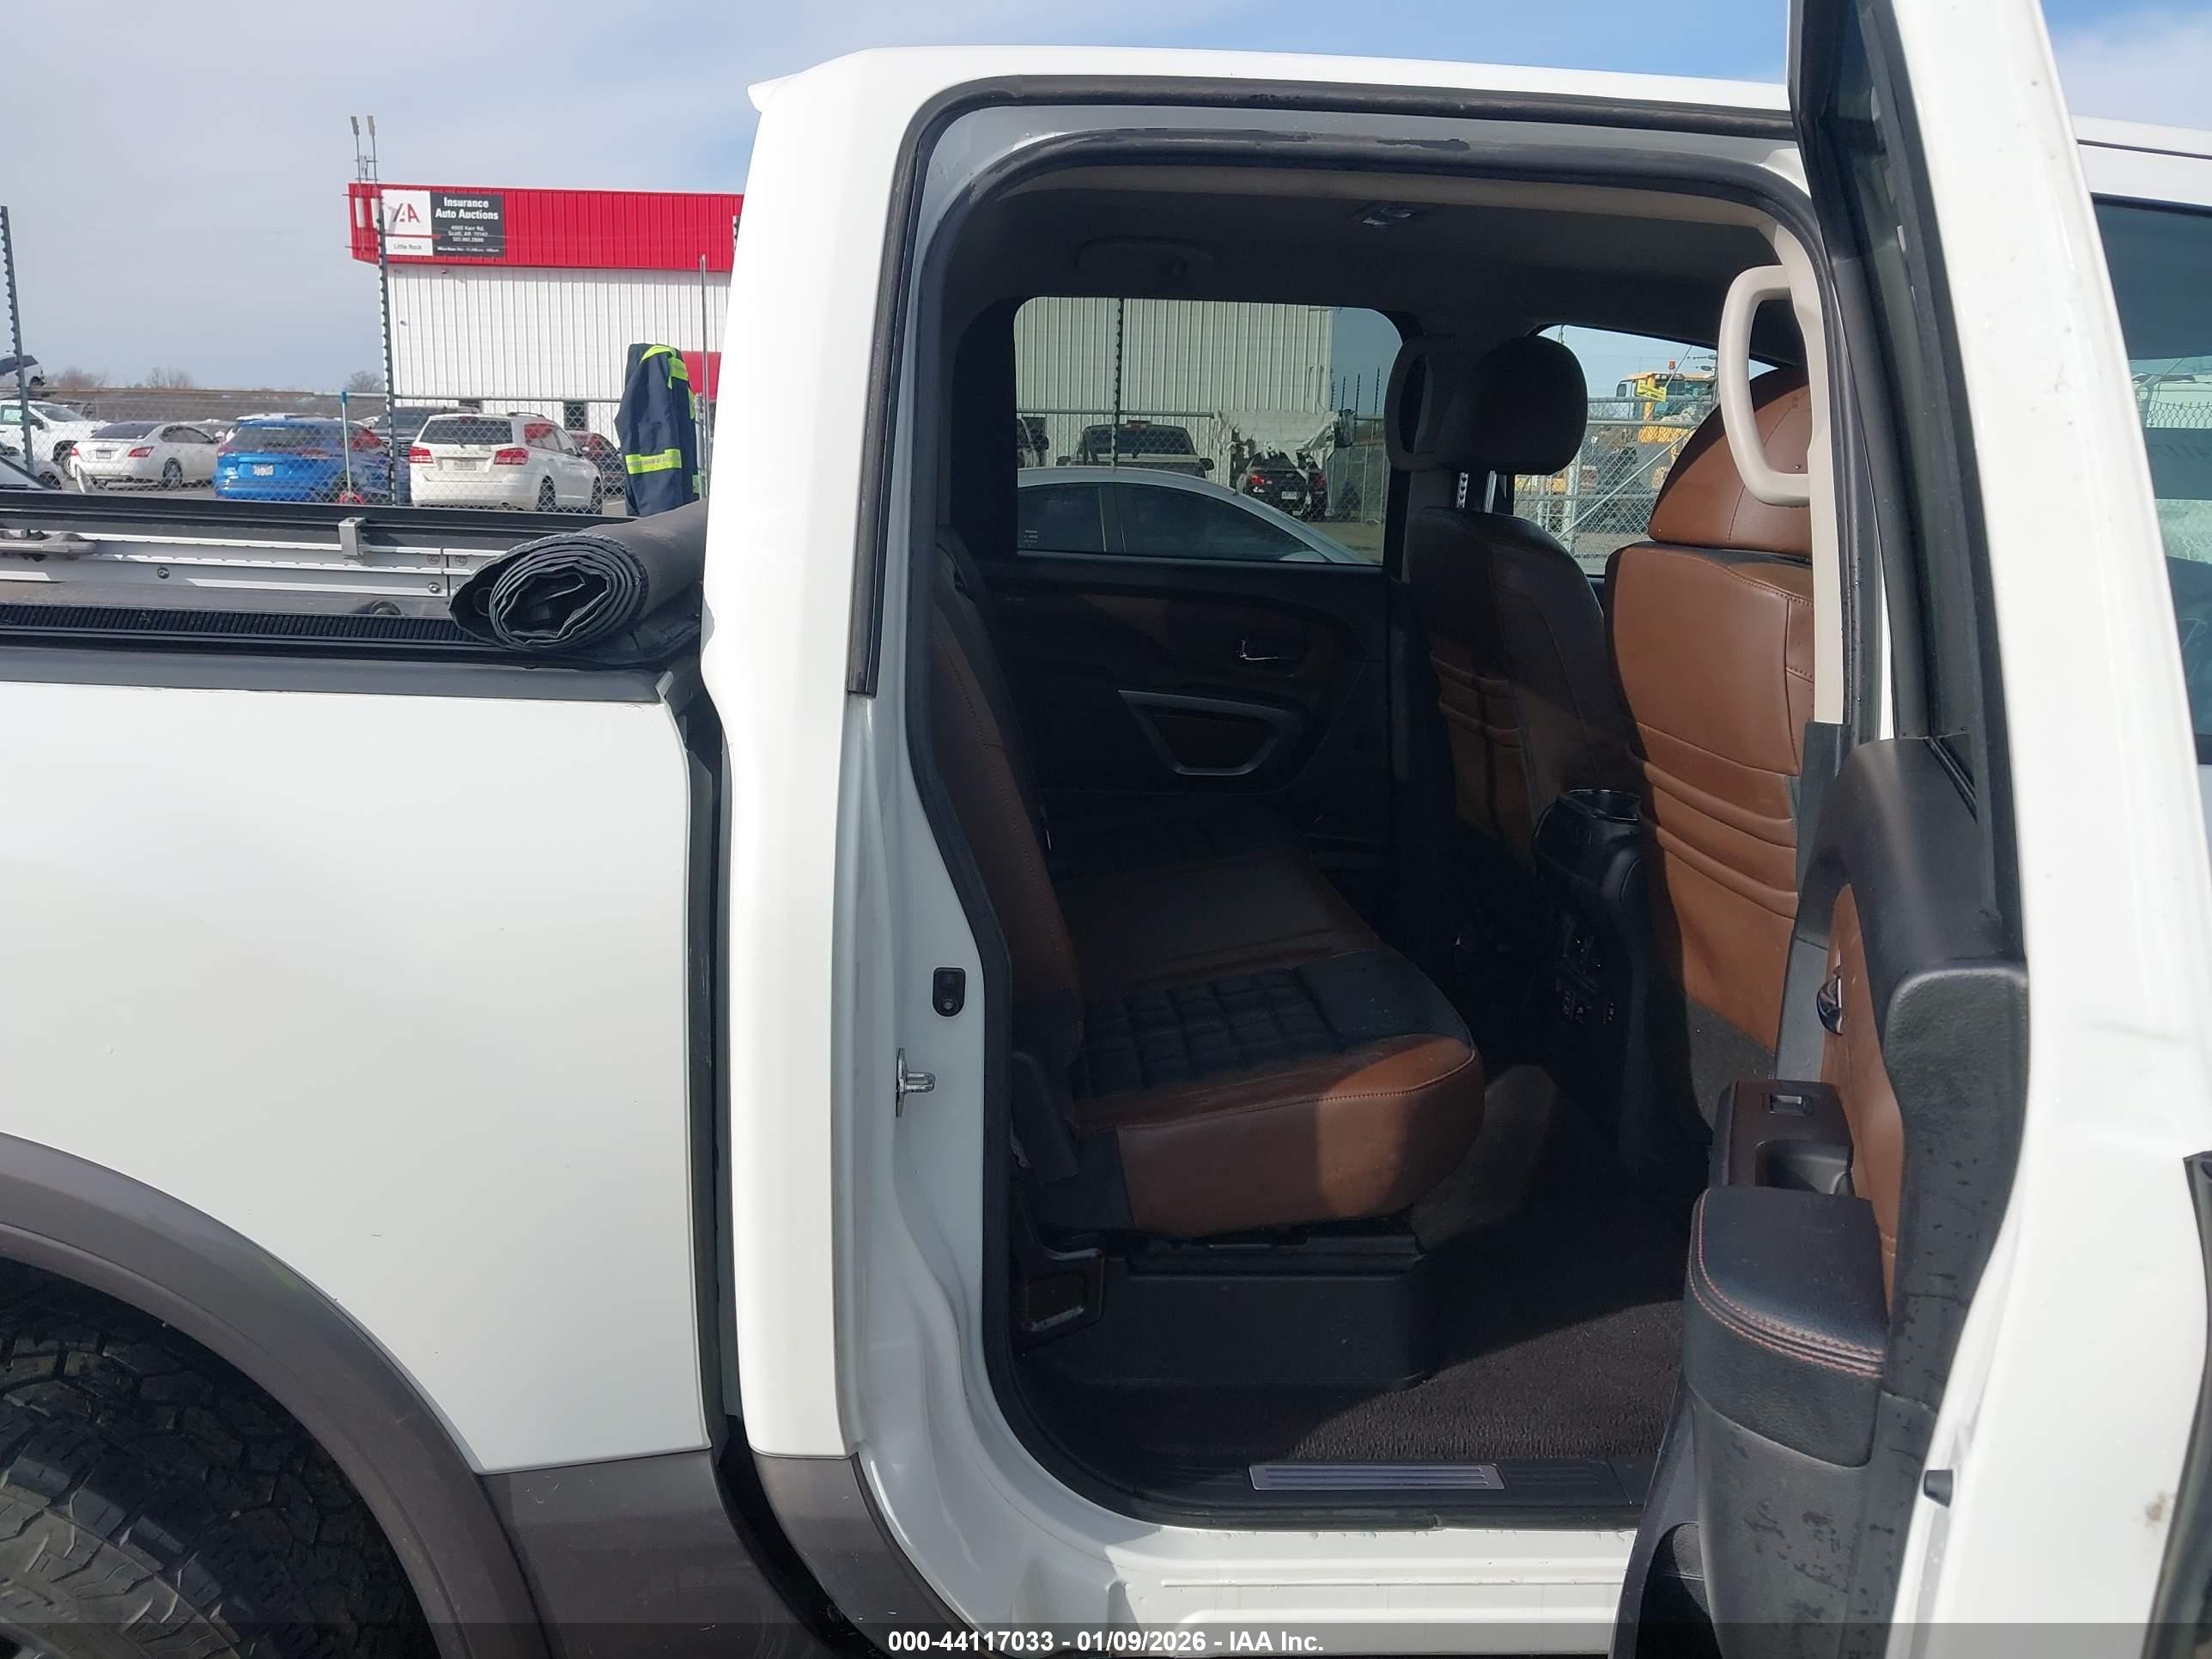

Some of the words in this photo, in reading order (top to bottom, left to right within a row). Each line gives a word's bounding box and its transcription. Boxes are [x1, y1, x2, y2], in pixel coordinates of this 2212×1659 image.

[443, 197, 489, 208] Insurance
[434, 208, 457, 218] Auto
[459, 209, 499, 220] Auctions
